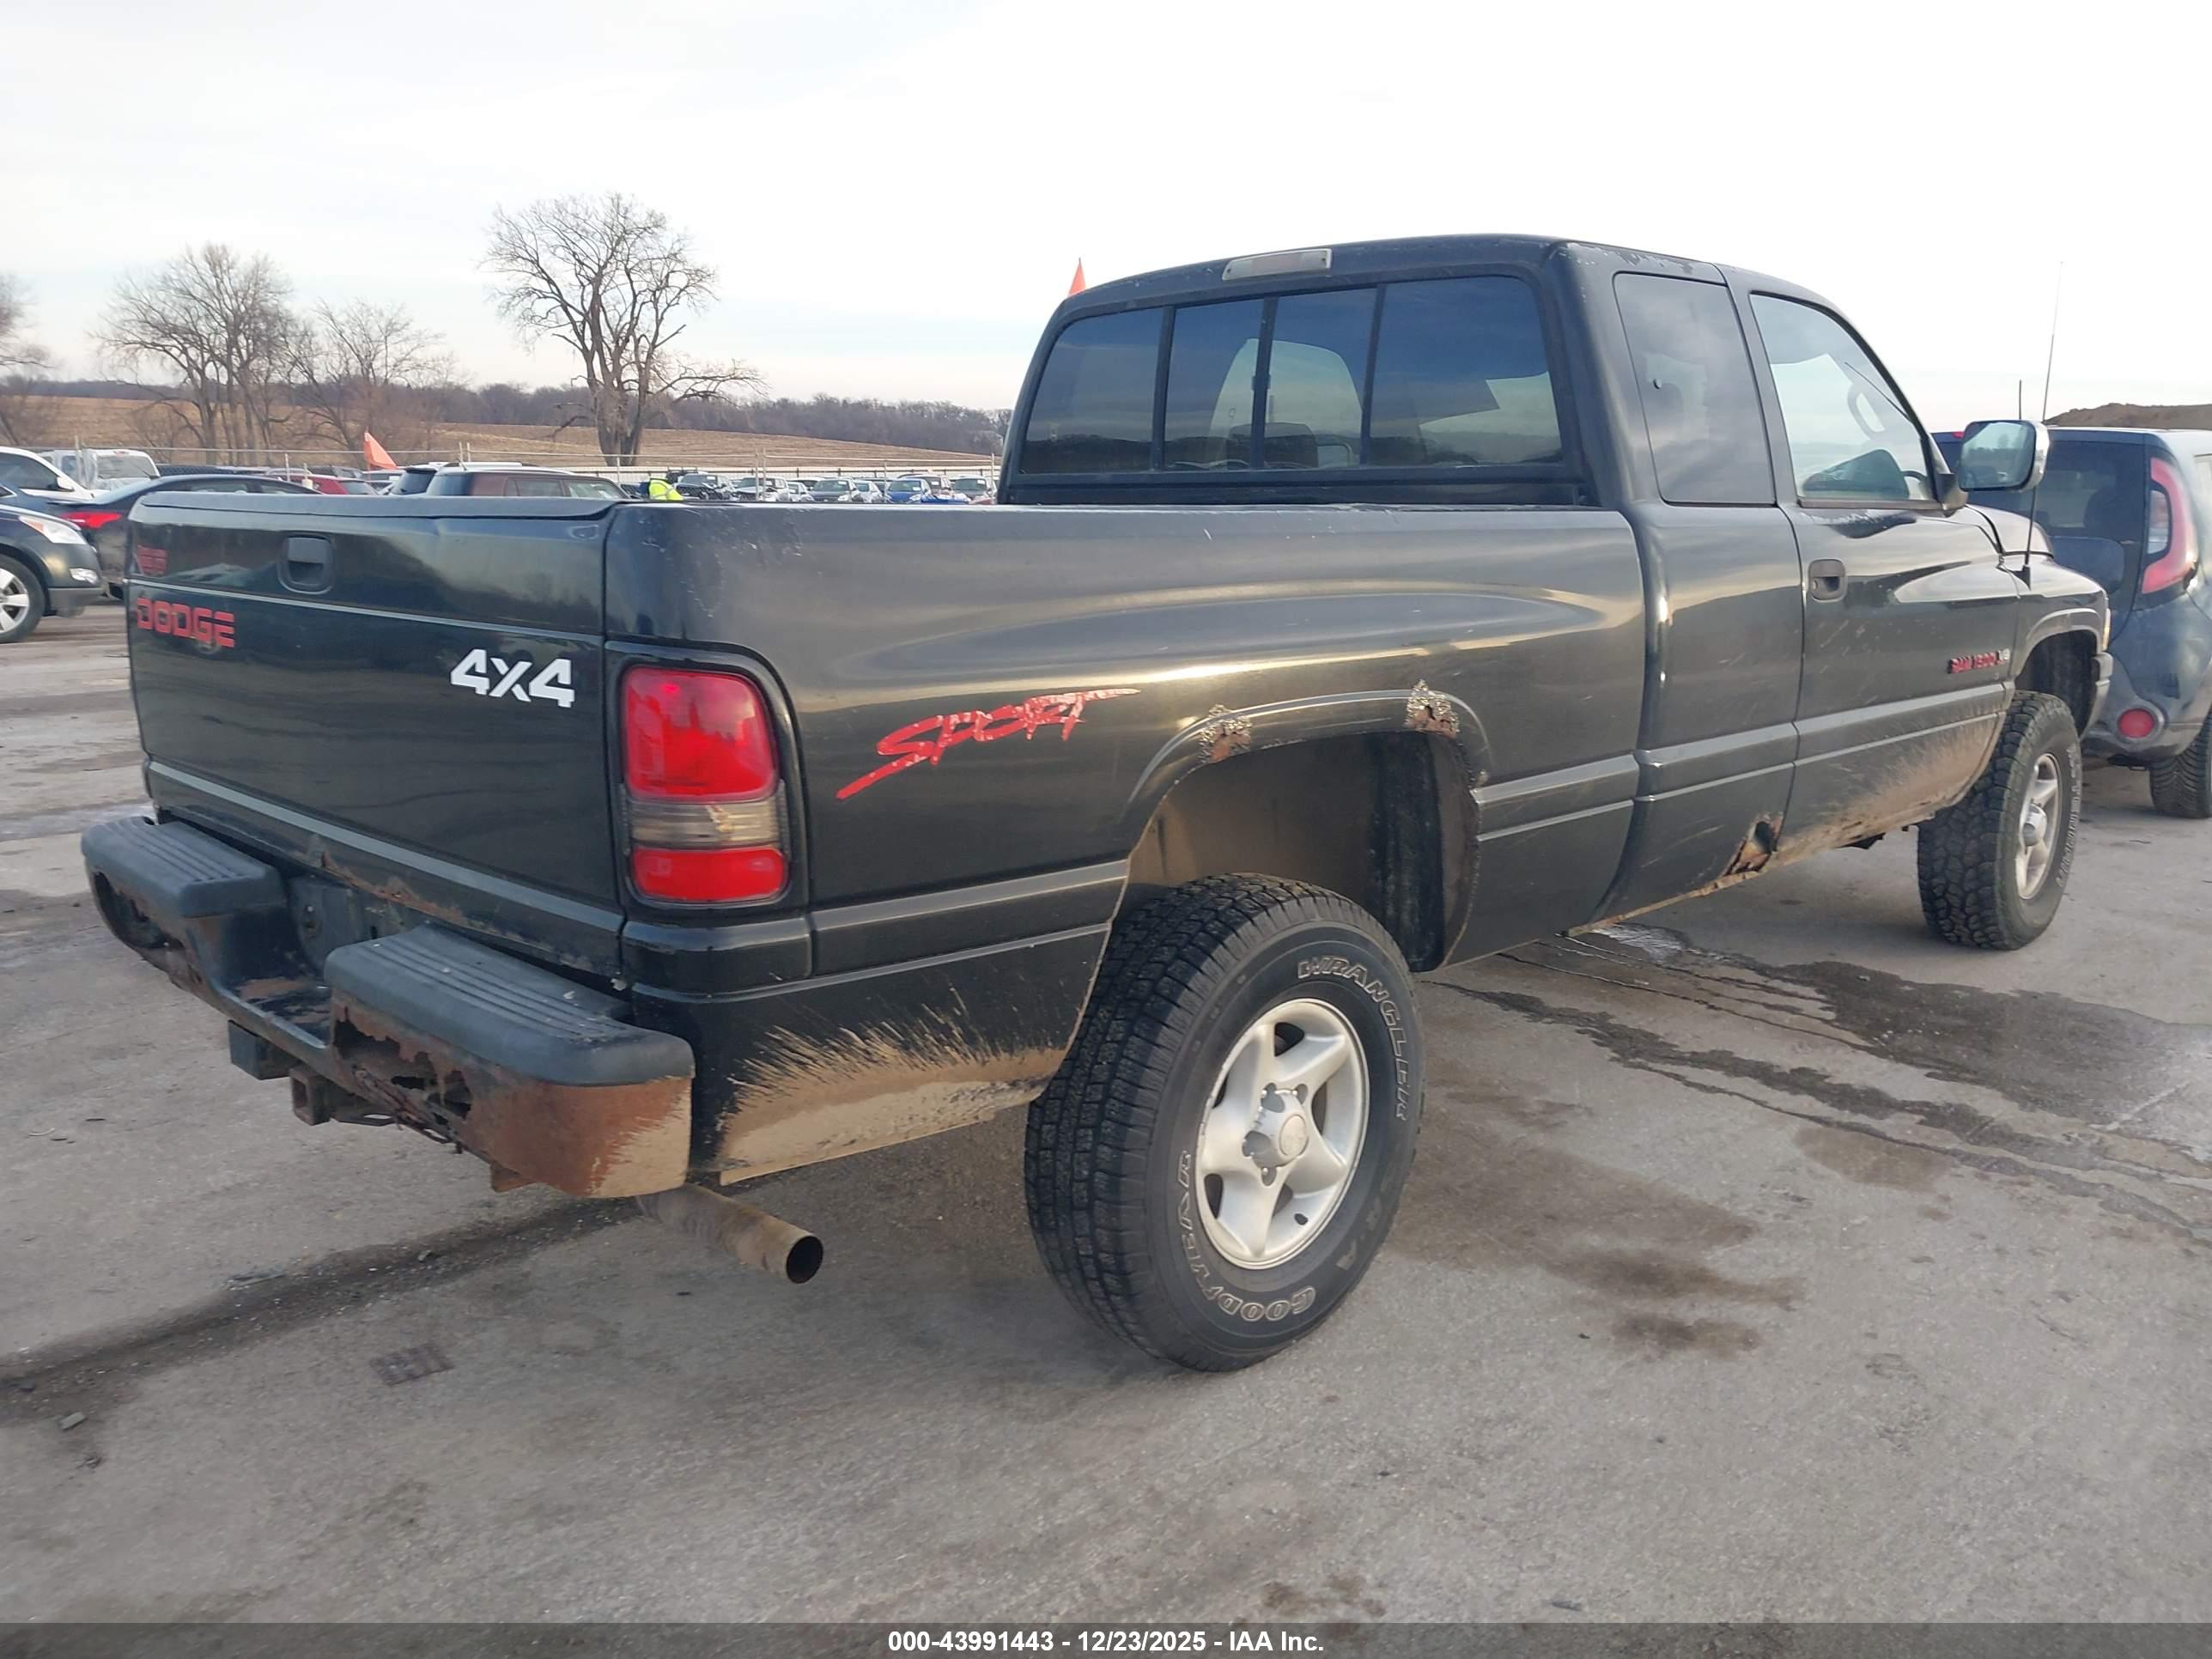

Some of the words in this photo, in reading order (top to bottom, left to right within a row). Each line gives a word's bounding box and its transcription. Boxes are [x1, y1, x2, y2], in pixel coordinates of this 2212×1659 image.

[137, 598, 234, 647] DODGE
[836, 688, 1141, 800] SPORT
[1297, 955, 1410, 1121] WRANGLER
[1177, 1150, 1316, 1322] GOODYEAR
